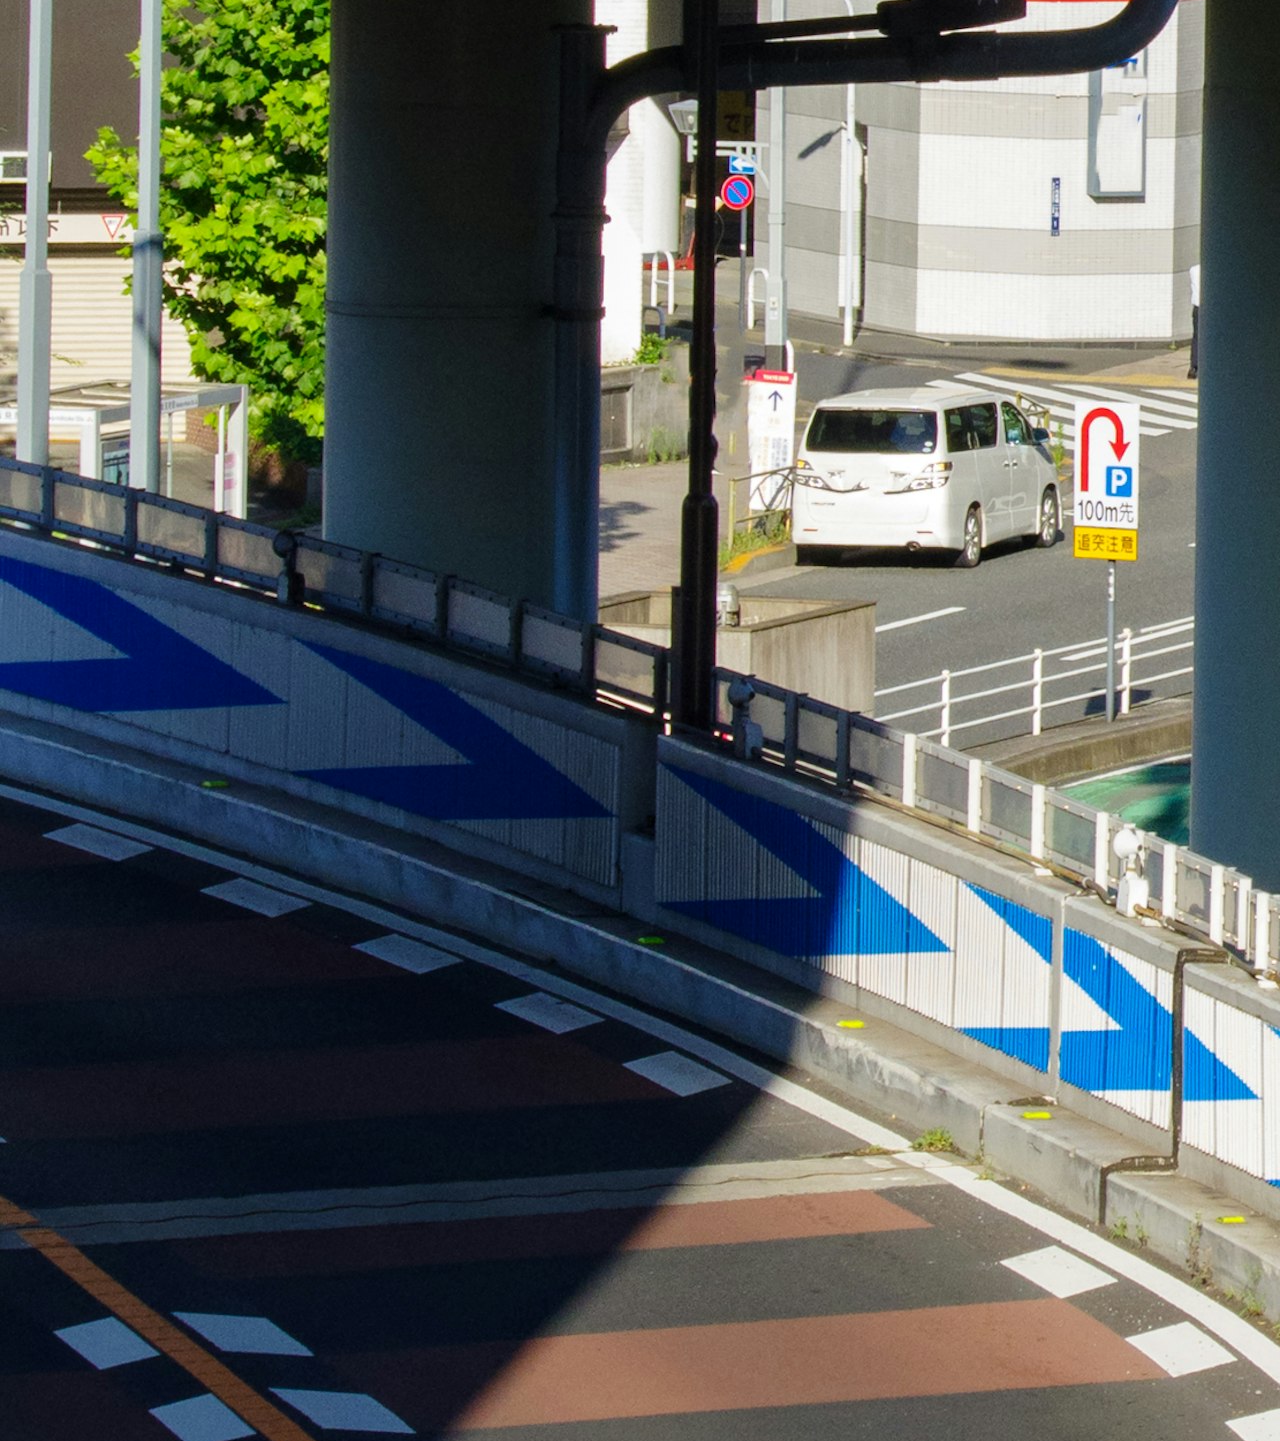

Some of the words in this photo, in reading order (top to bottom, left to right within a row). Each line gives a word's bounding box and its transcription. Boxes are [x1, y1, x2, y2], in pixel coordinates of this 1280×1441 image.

[1077, 499, 1135, 524] 100m先
[1077, 532, 1135, 555] 追突注意
